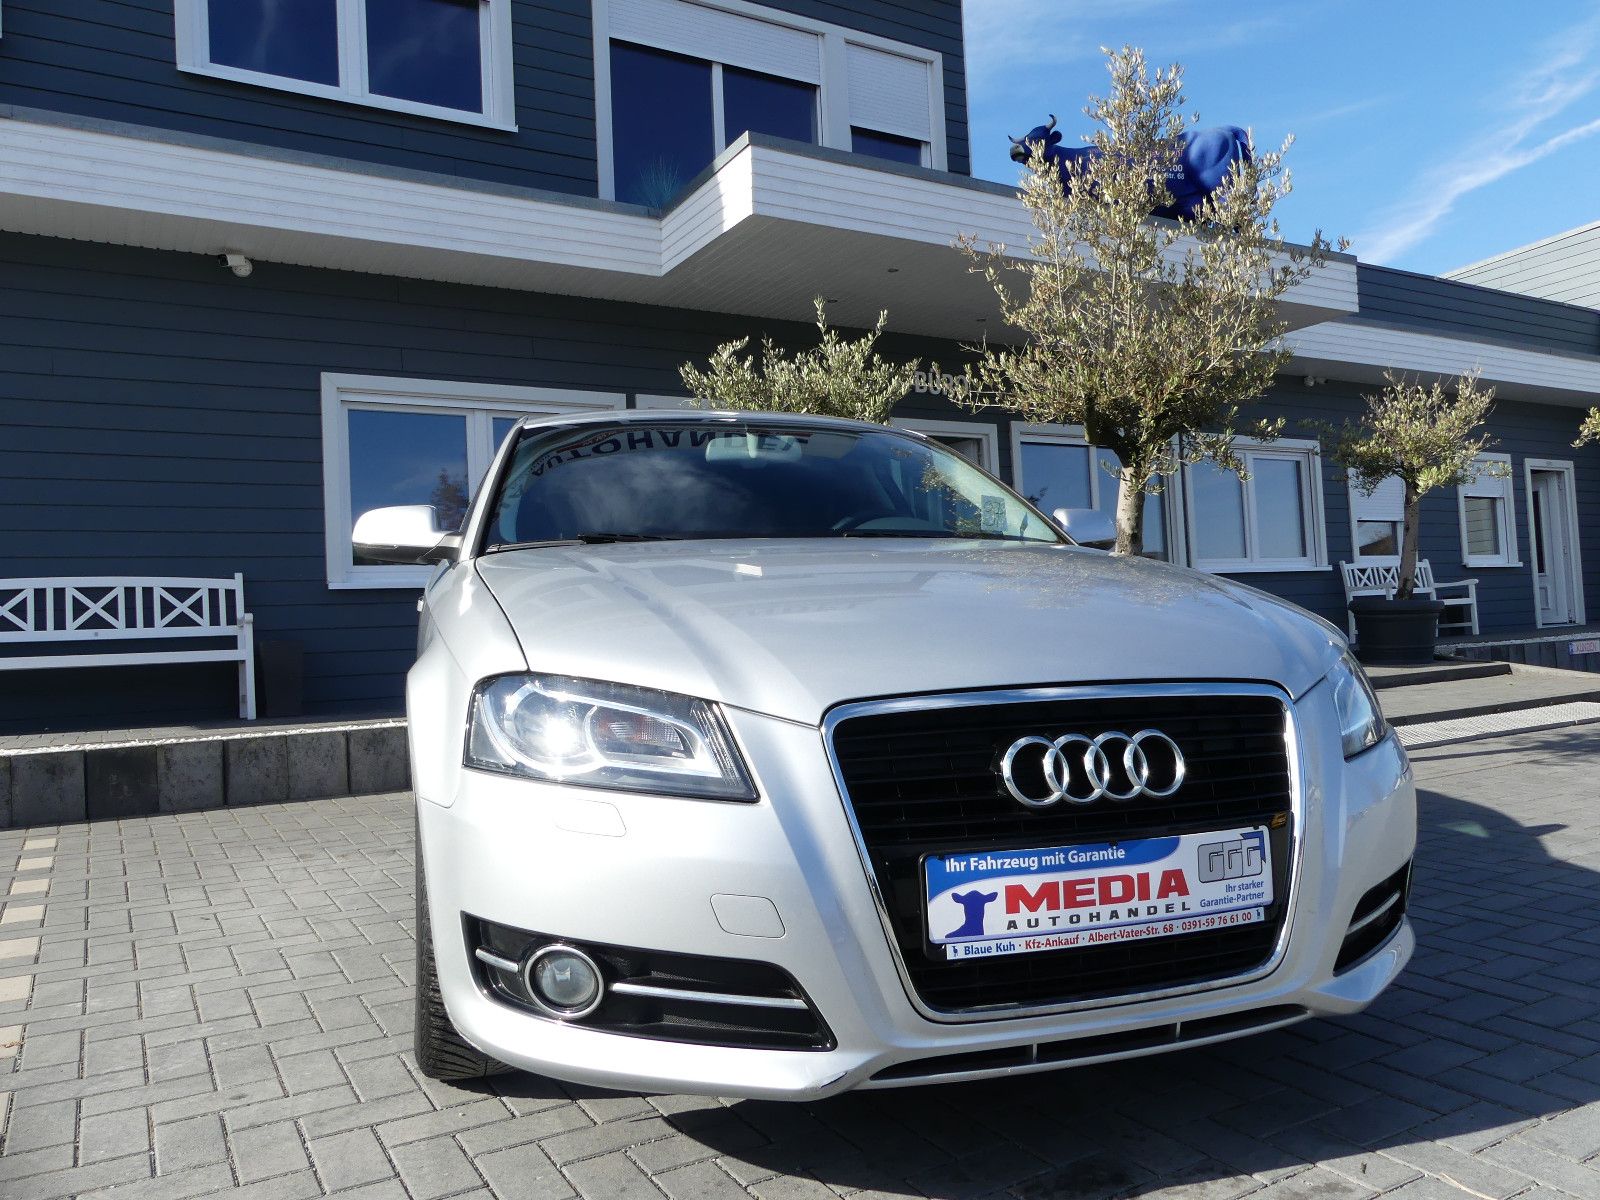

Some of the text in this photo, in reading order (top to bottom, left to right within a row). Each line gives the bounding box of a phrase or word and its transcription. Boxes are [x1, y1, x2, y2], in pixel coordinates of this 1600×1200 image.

[945, 846, 1126, 872] Ihr Fahrzeug mit Garantie
[1005, 868, 1190, 915] MEDIA
[1199, 890, 1265, 908] Garantie-Partner
[1225, 880, 1264, 893] Ihr starker
[1007, 901, 1191, 931] AUTOHANDEL
[964, 911, 1252, 956] Blaue Kuh Kfz-Ankauf Albert-Vater-Str. 68 0391-59 76 61 00
